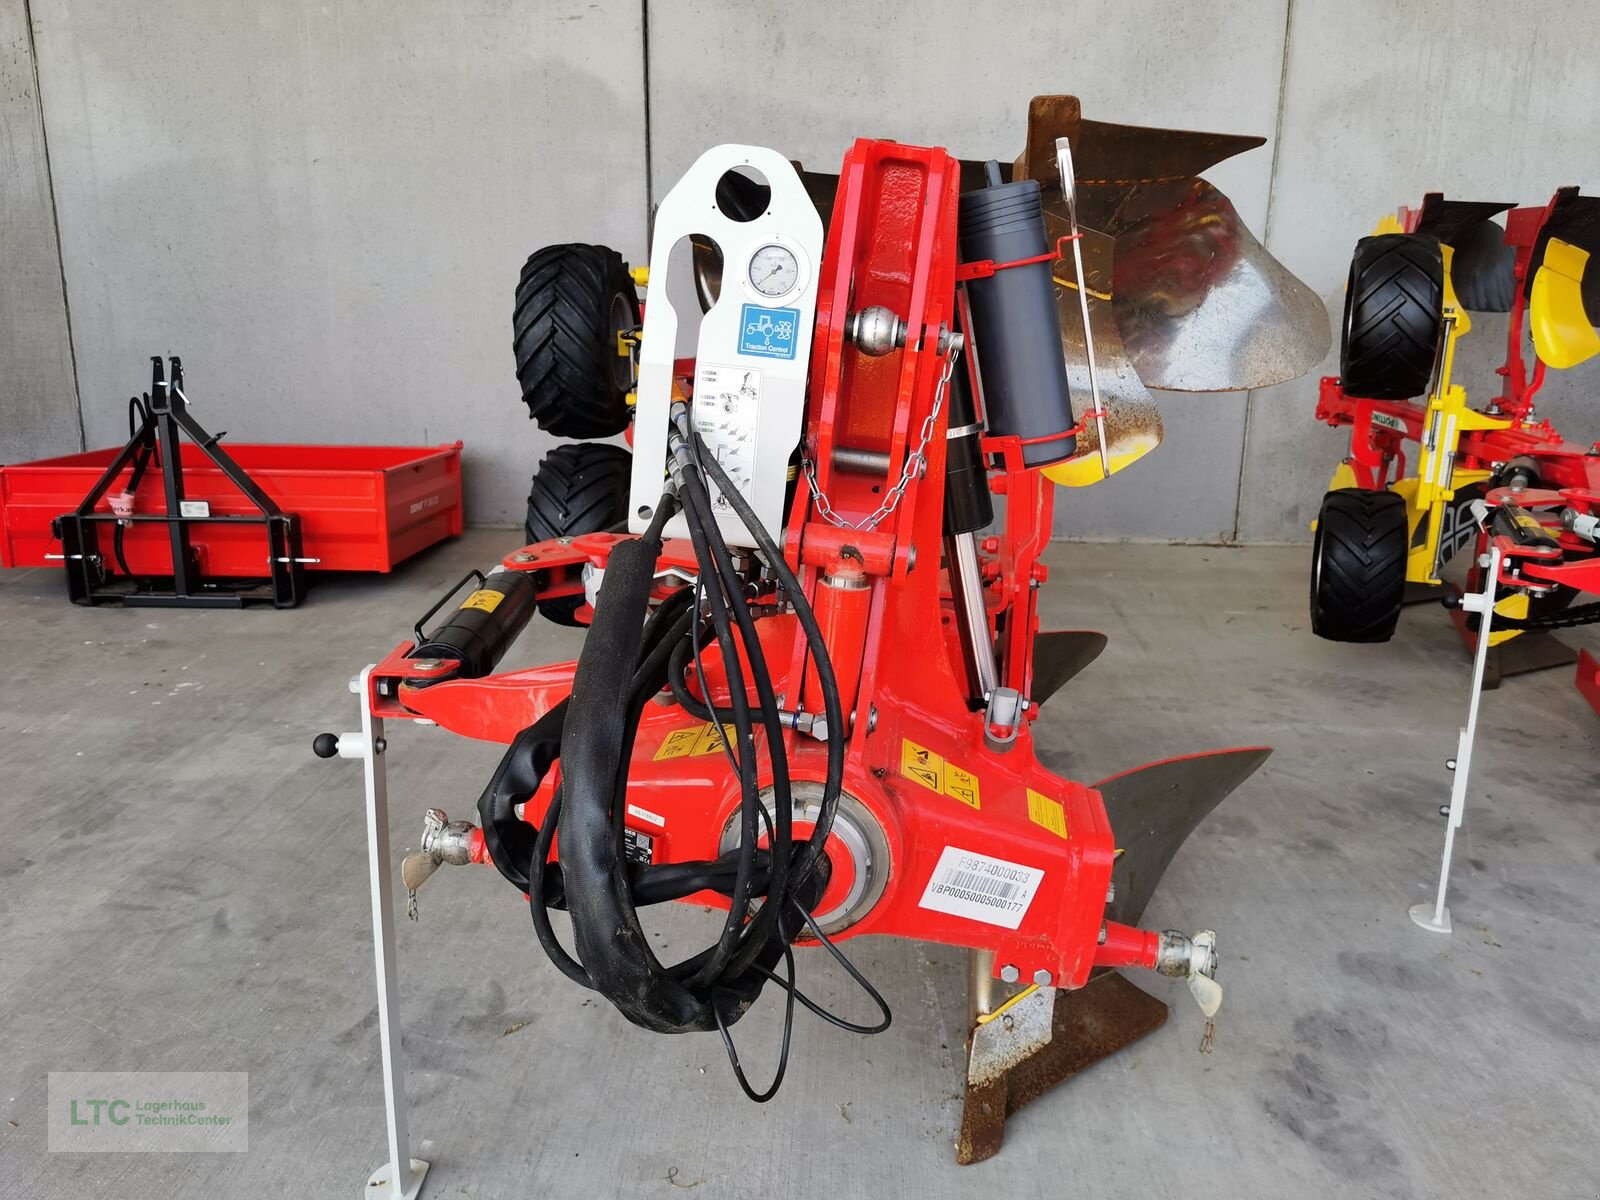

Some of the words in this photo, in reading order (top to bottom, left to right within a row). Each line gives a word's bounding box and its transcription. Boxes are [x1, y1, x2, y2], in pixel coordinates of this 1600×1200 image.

[746, 343, 767, 351] Traction
[768, 345, 788, 353] Control
[958, 856, 1030, 883] F9874000033
[931, 882, 1023, 913] VBP00050005000177
